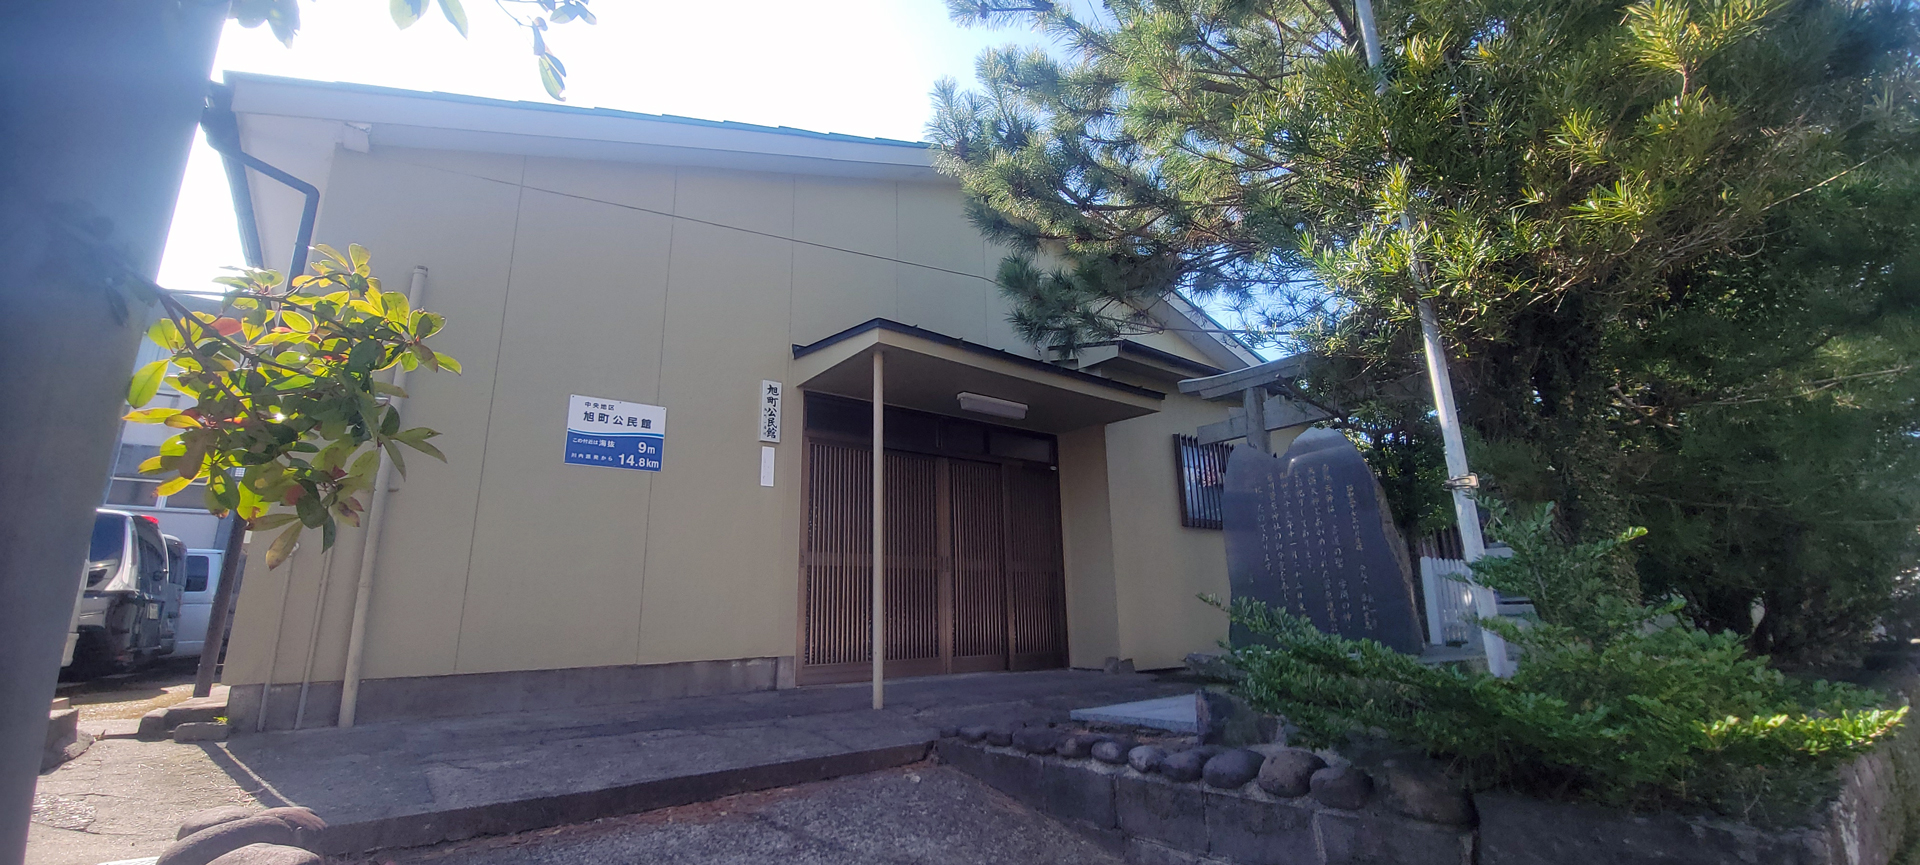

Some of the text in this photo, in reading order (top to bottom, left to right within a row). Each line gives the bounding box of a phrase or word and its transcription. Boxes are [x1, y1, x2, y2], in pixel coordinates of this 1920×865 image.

[584, 401, 615, 411] 中央地区
[767, 384, 779, 439] 旭町公民館
[583, 411, 652, 429] 旭町公民館
[618, 453, 659, 468] 14.8km
